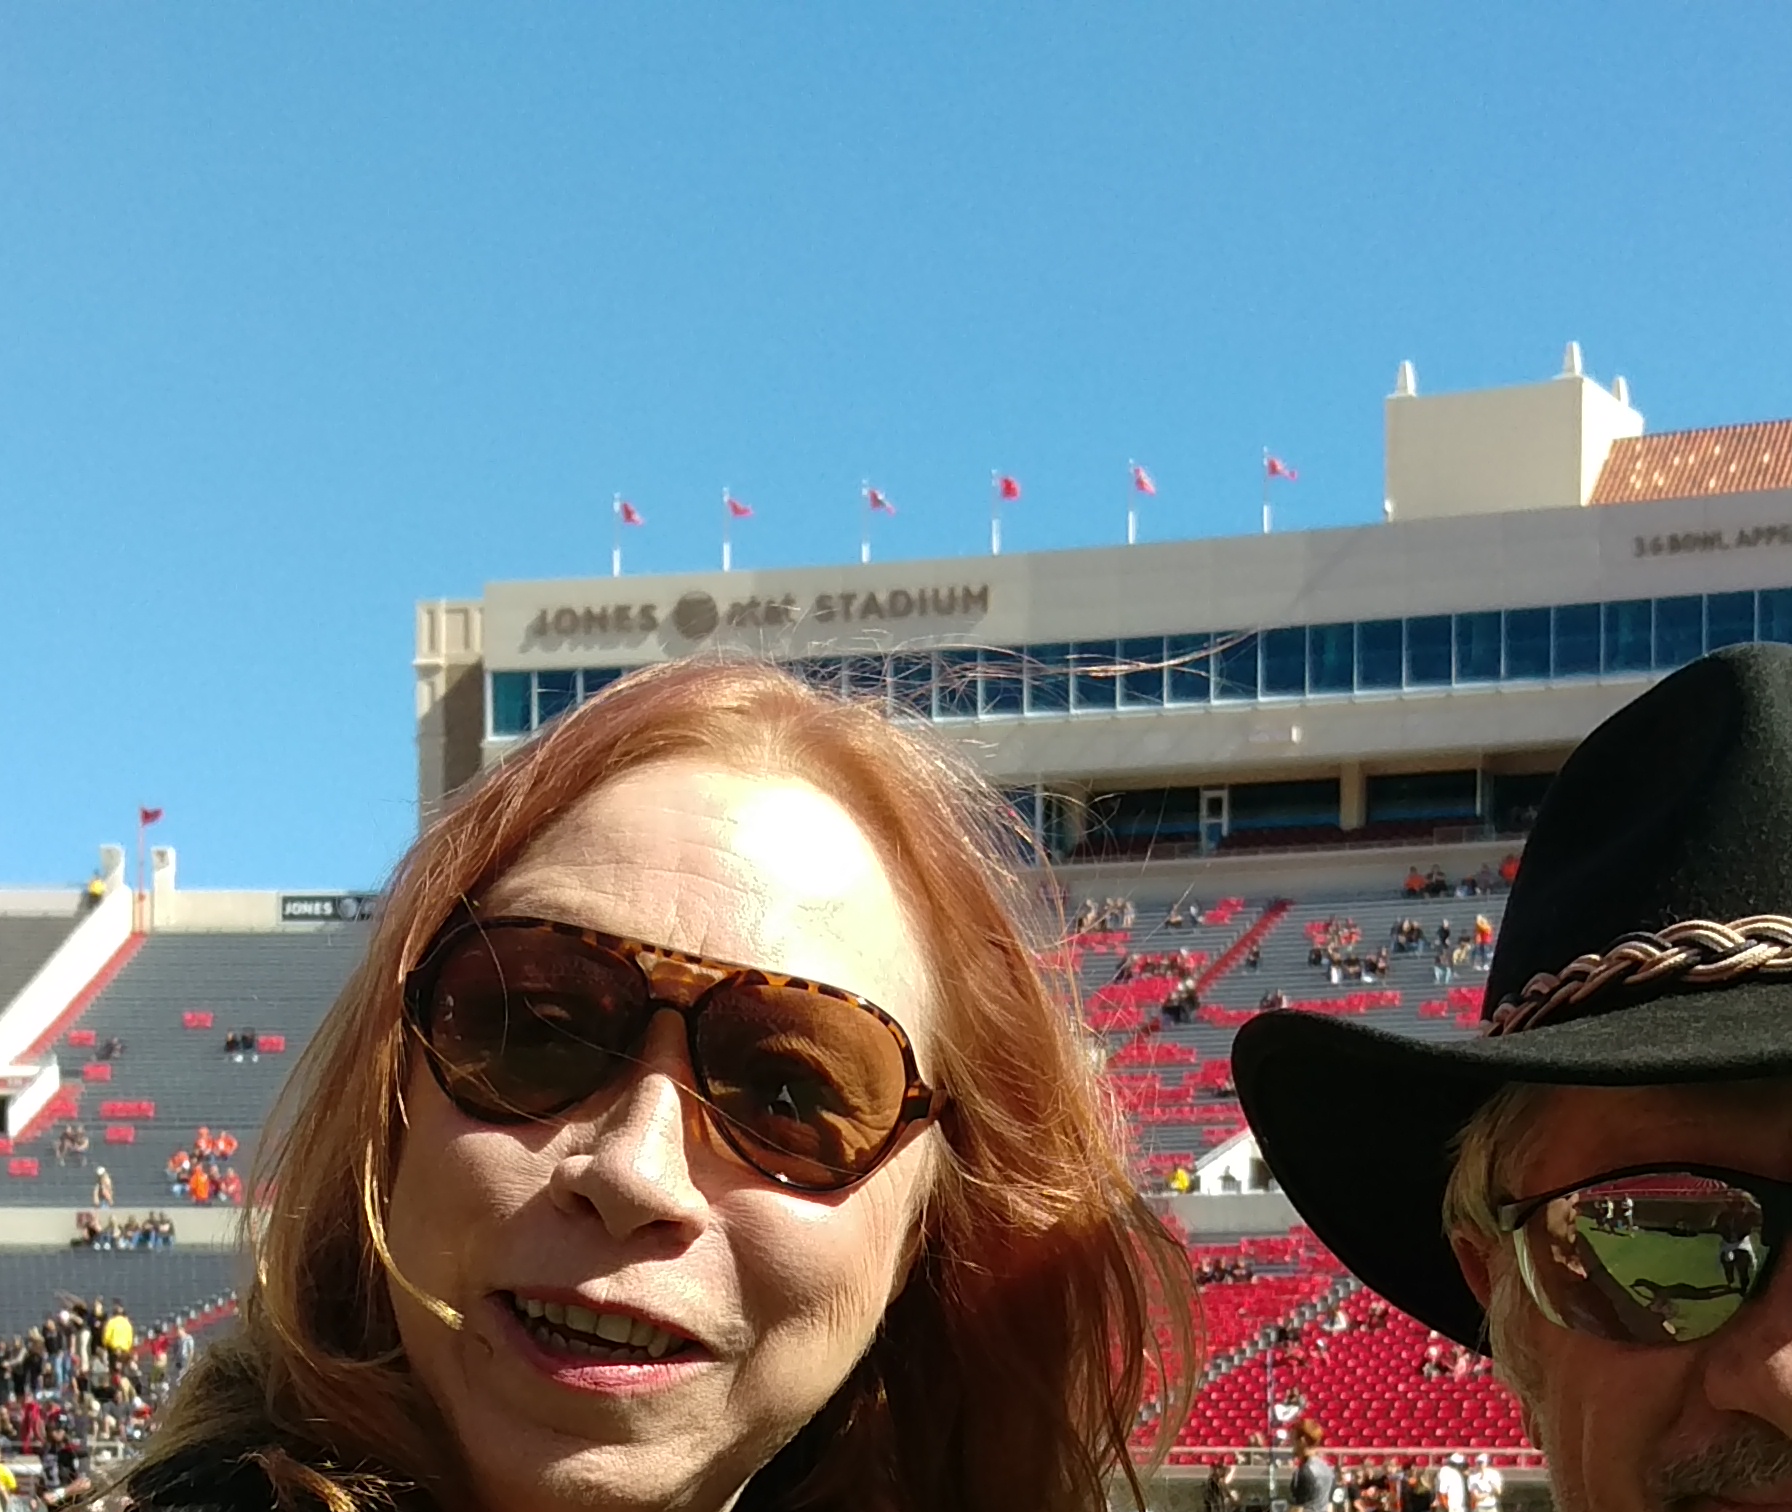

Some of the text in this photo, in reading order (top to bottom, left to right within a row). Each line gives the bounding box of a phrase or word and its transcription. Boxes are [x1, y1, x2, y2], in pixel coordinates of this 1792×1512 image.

[532, 603, 658, 636] JONES
[814, 584, 989, 623] STADIUM
[285, 901, 334, 916] JONES
